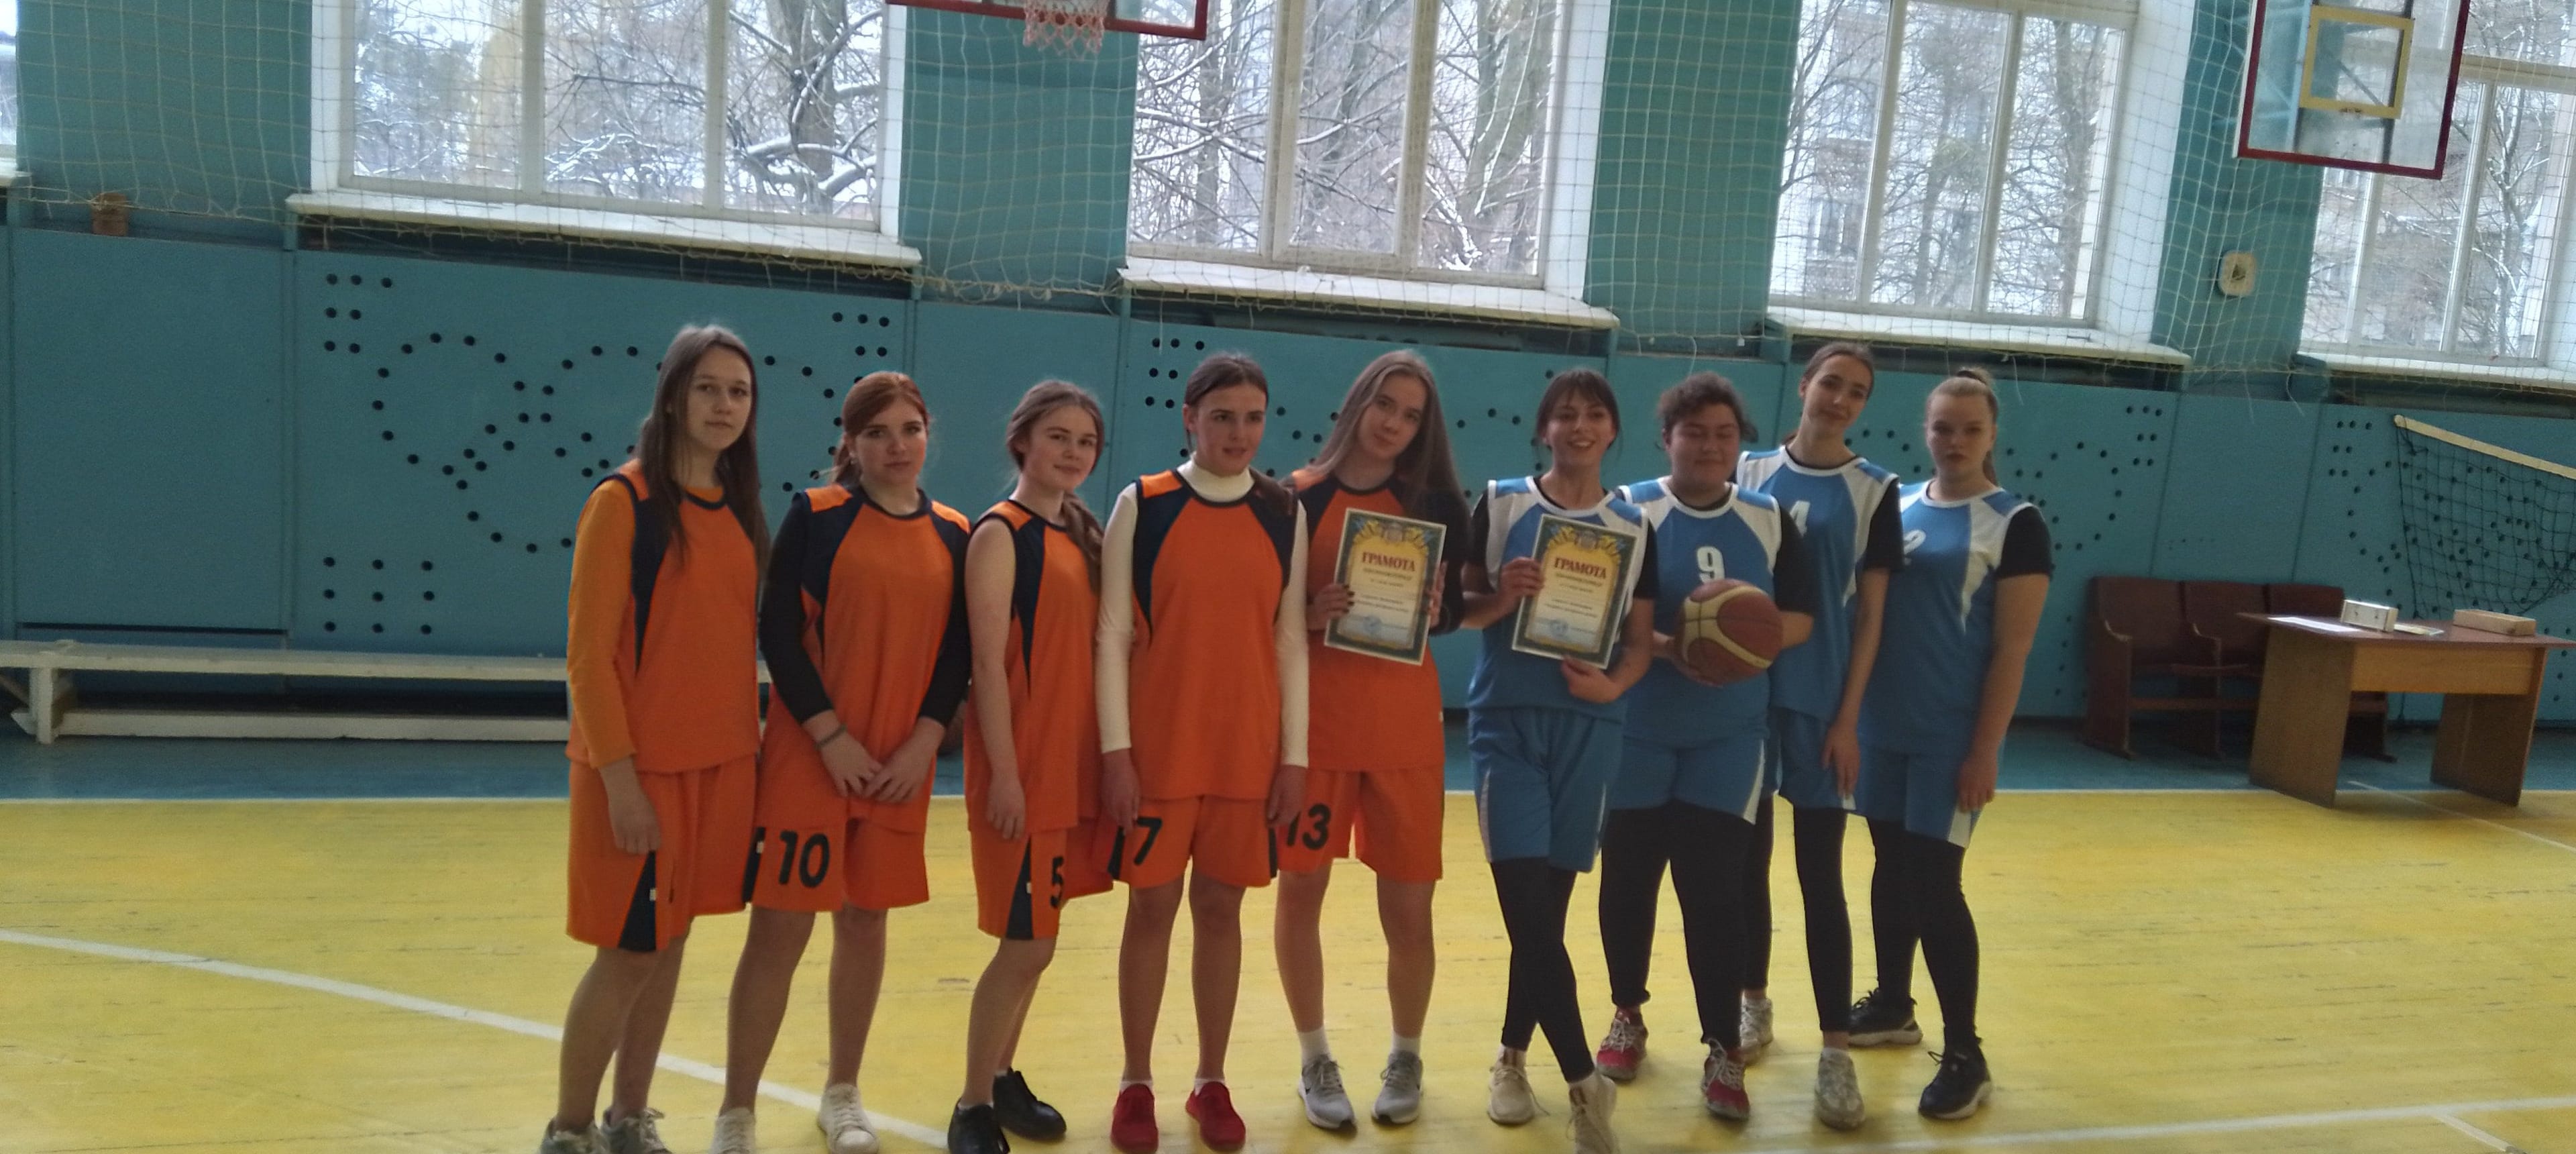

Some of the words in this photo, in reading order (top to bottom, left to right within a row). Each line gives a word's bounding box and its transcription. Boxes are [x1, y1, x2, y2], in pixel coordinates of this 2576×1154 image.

[1362, 551, 1416, 572] ГРАМОТА
[1554, 557, 1607, 579] ГРАМОТА
[1697, 546, 1725, 583] 9
[1134, 815, 1163, 866] 7
[1286, 803, 1331, 850] 13
[778, 830, 830, 888] 10
[1050, 855, 1065, 908] 5
